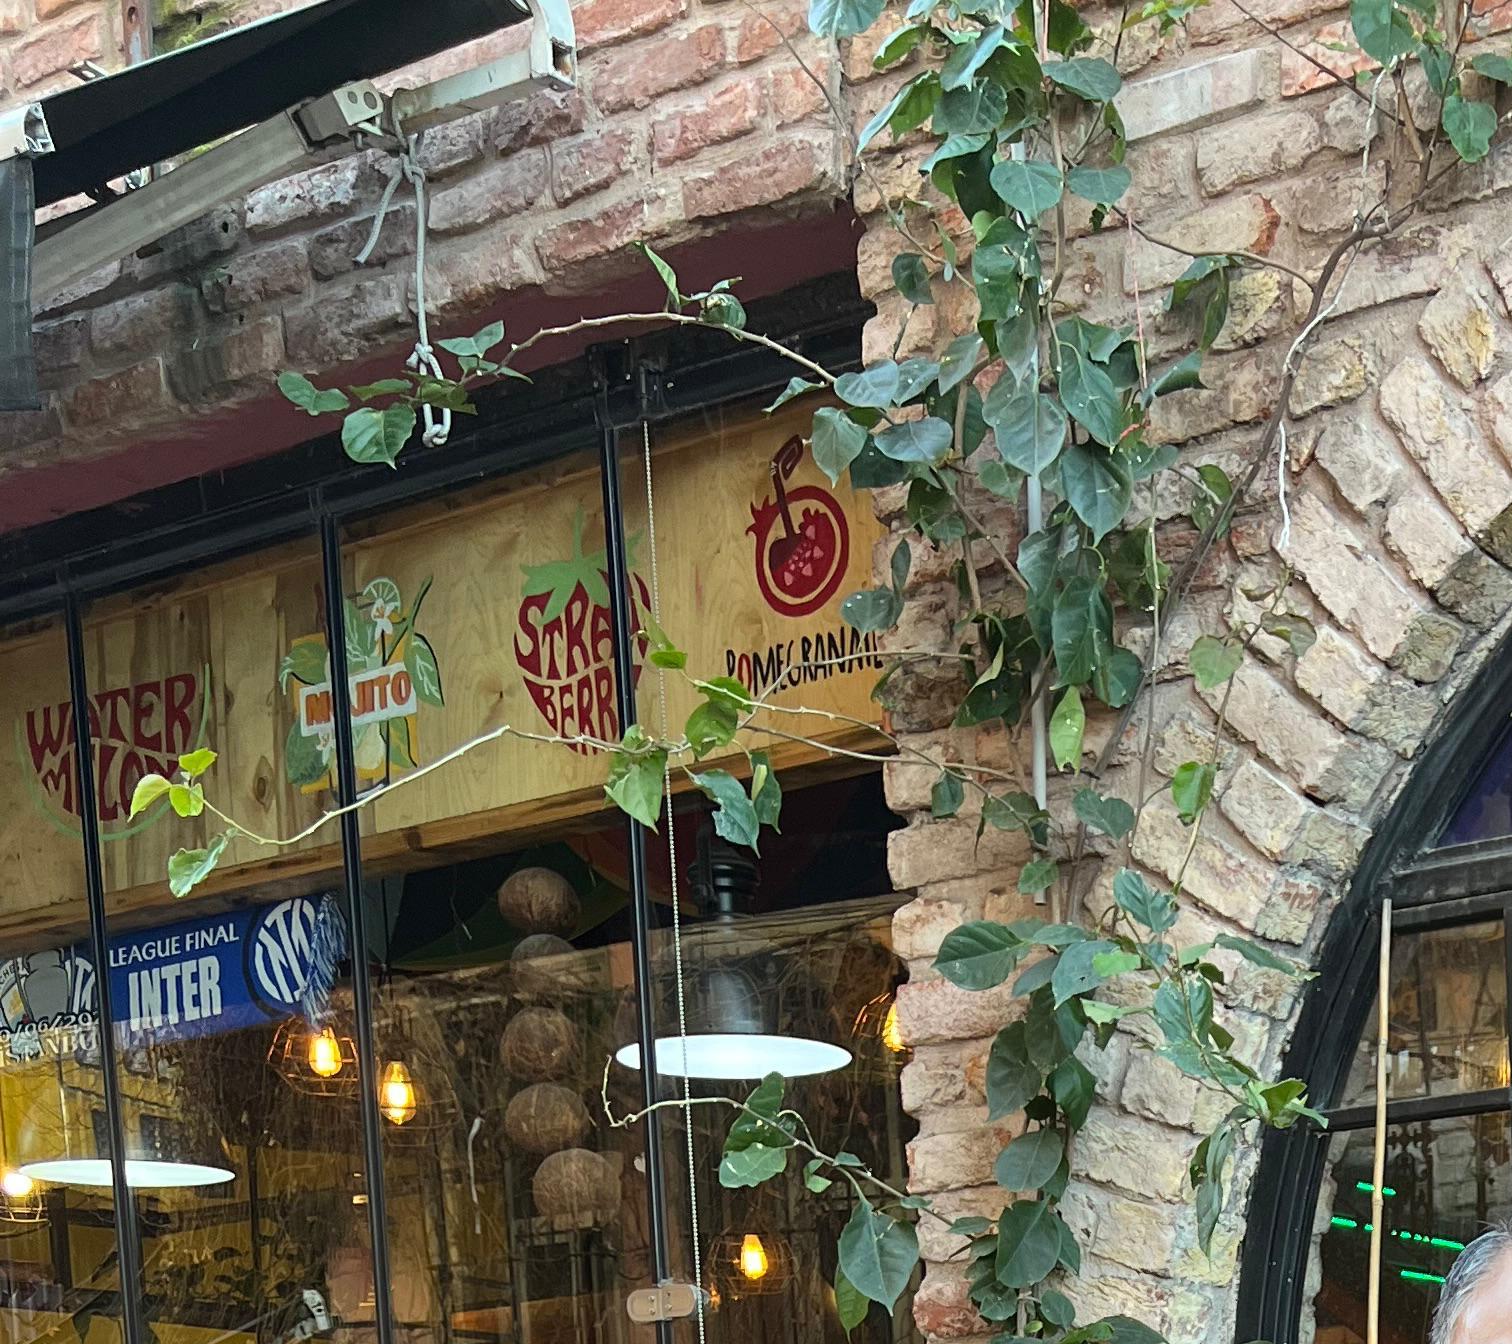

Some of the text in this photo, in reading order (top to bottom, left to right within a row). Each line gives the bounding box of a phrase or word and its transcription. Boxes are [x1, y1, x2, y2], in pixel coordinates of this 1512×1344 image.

[305, 670, 411, 727] MJITO
[522, 664, 642, 756] BERR
[109, 922, 240, 967] LEAGUE FINAL
[128, 955, 222, 1032] INTER
